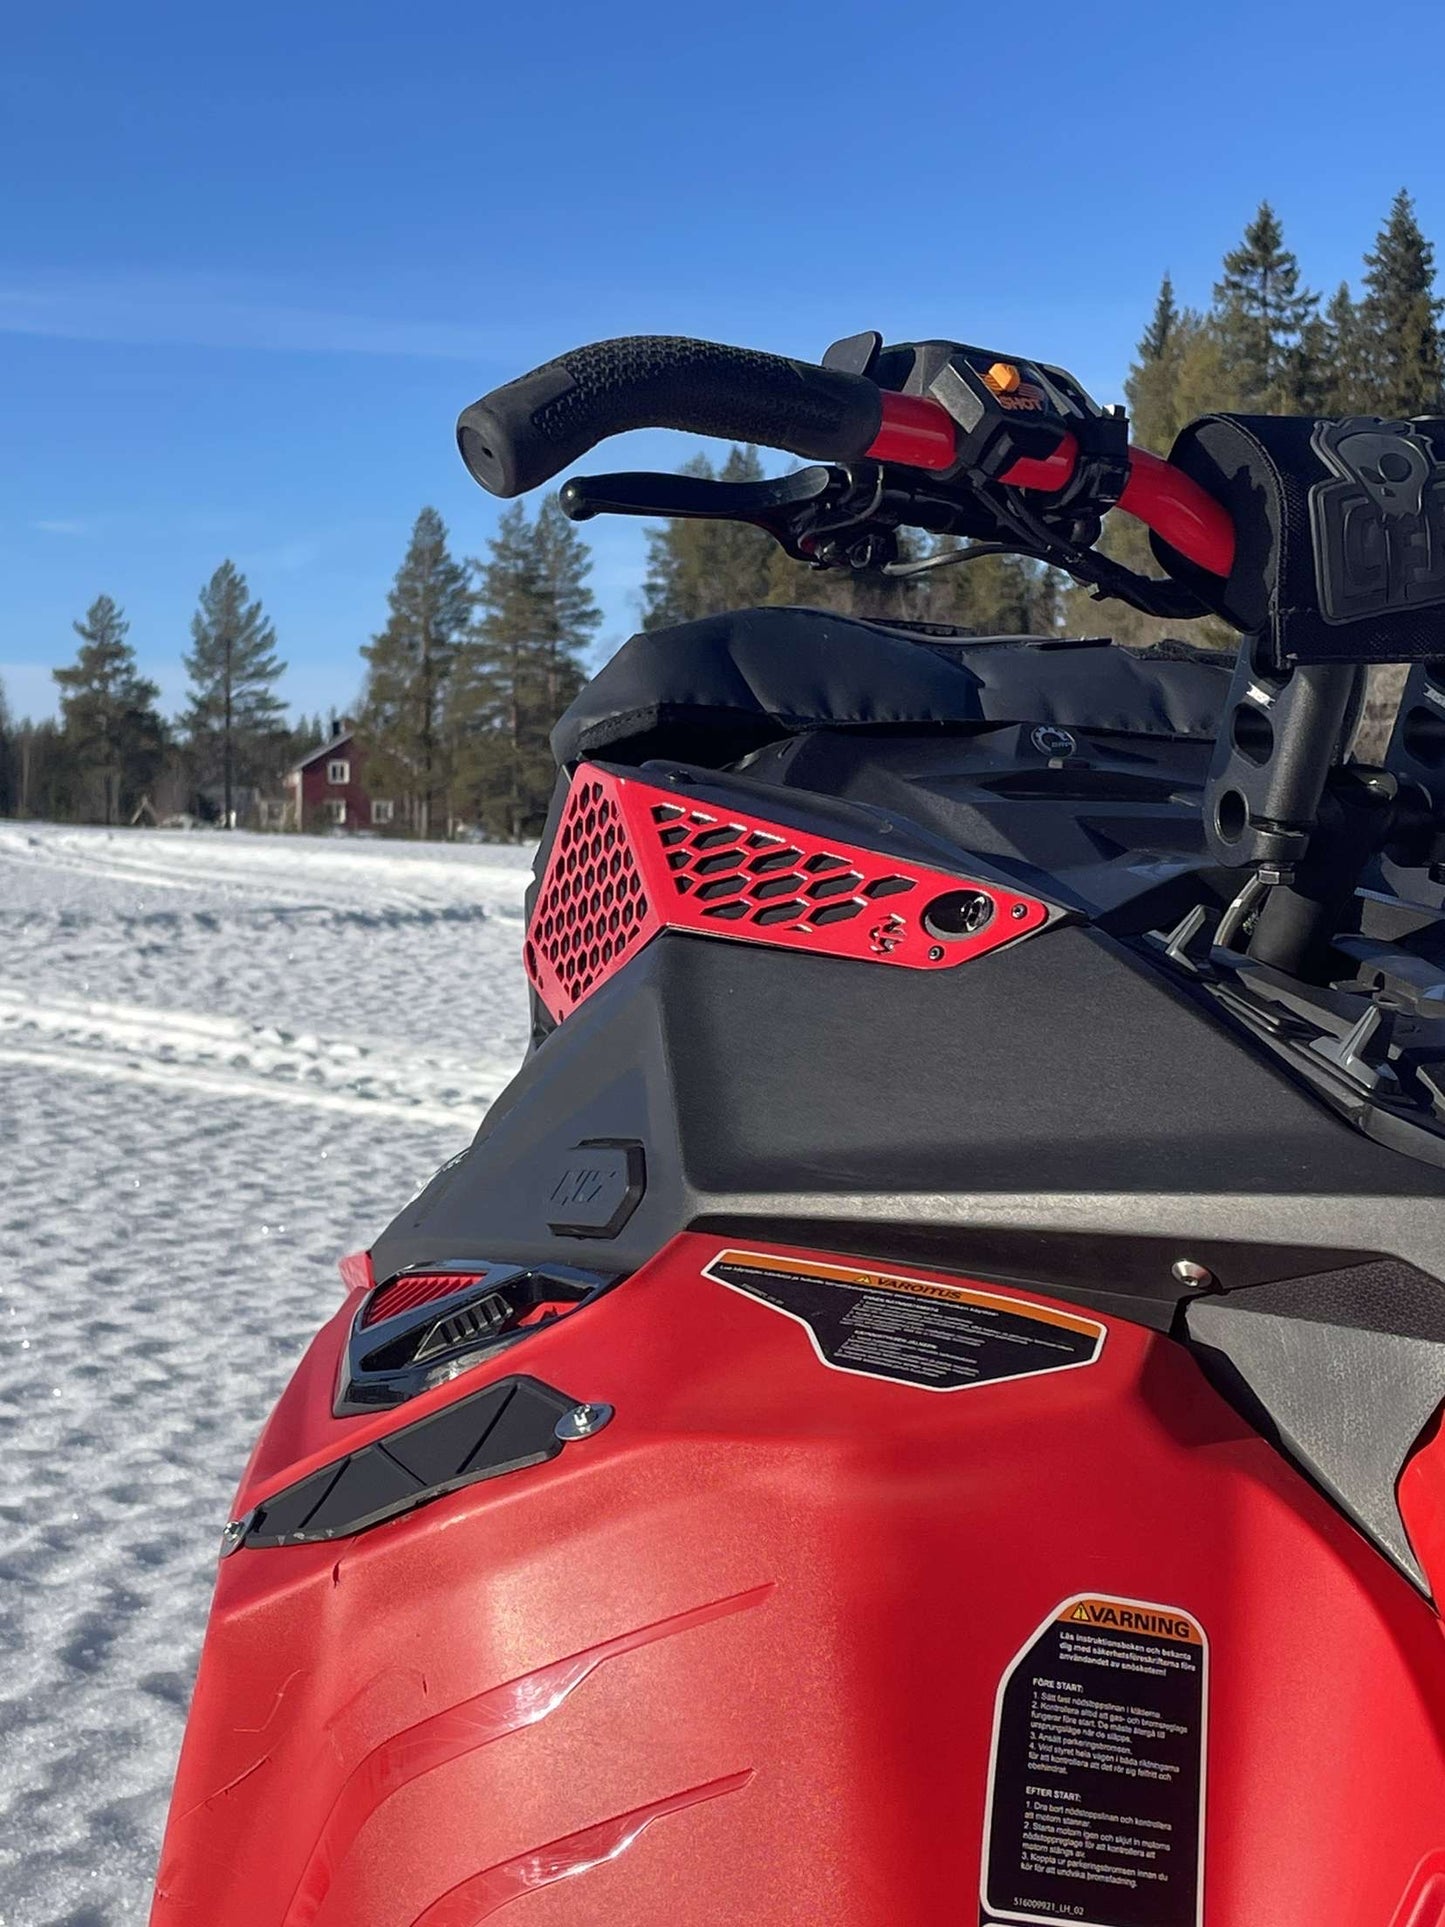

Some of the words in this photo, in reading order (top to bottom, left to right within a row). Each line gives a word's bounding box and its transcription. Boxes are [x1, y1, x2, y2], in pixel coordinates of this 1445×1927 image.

[1000, 395, 1042, 411] SHOT
[1089, 1605, 1189, 1638] VARNING
[1060, 1631, 1074, 1641] Läs
[1146, 1645, 1160, 1656] och
[1162, 1648, 1191, 1661] bekanta
[1059, 1641, 1071, 1652] dig
[1073, 1644, 1091, 1654] med
[1181, 1661, 1196, 1671] före
[1059, 1652, 1108, 1667] användandet
[1032, 1677, 1054, 1689] FÖRE
[1056, 1681, 1083, 1693] START:
[1033, 1690, 1039, 1699] 1.
[1031, 1700, 1039, 1709] 2.
[1099, 1711, 1108, 1720] att
[1109, 1715, 1125, 1725] gas-
[1127, 1716, 1140, 1725] och
[1062, 1715, 1076, 1725] före
[1078, 1718, 1096, 1728] start.
[1098, 1721, 1108, 1730] De
[1030, 1731, 1037, 1740] 3.
[1082, 1728, 1094, 1737] när
[1096, 1730, 1105, 1739] de
[1029, 1741, 1036, 1750] 4.
[1075, 1749, 1091, 1758] hela
[1115, 1755, 1118, 1763] i
[1119, 1756, 1137, 1766] båda
[1028, 1752, 1039, 1760] för
[1040, 1753, 1049, 1762] att
[1051, 1755, 1088, 1768] kontrollera
[1090, 1761, 1099, 1769] att
[1101, 1763, 1112, 1771] det
[1125, 1767, 1136, 1777] sig
[1158, 1772, 1171, 1781] och
[1026, 1786, 1052, 1798] EFTER
[1053, 1790, 1081, 1802] START:
[1024, 1811, 1034, 1819] att
[1026, 1800, 1032, 1809] 1.
[1033, 1801, 1047, 1811] Dra
[1049, 1804, 1063, 1814] bort
[1120, 1815, 1133, 1825] och
[1023, 1821, 1031, 1830] 2.
[1032, 1822, 1054, 1833] Starta
[1083, 1830, 1098, 1842] igen
[1100, 1832, 1114, 1842] och
[1115, 1835, 1132, 1847] skjut
[1133, 1838, 1140, 1846] in
[1084, 1840, 1094, 1849] för
[1096, 1842, 1105, 1851] att
[1146, 1850, 1155, 1859] att
[1020, 1861, 1033, 1871] kör
[1034, 1864, 1044, 1873] för
[1045, 1865, 1055, 1874] att
[1022, 1851, 1028, 1860] 3.
[1057, 1858, 1065, 1866] ur
[1158, 1872, 1168, 1881] du
